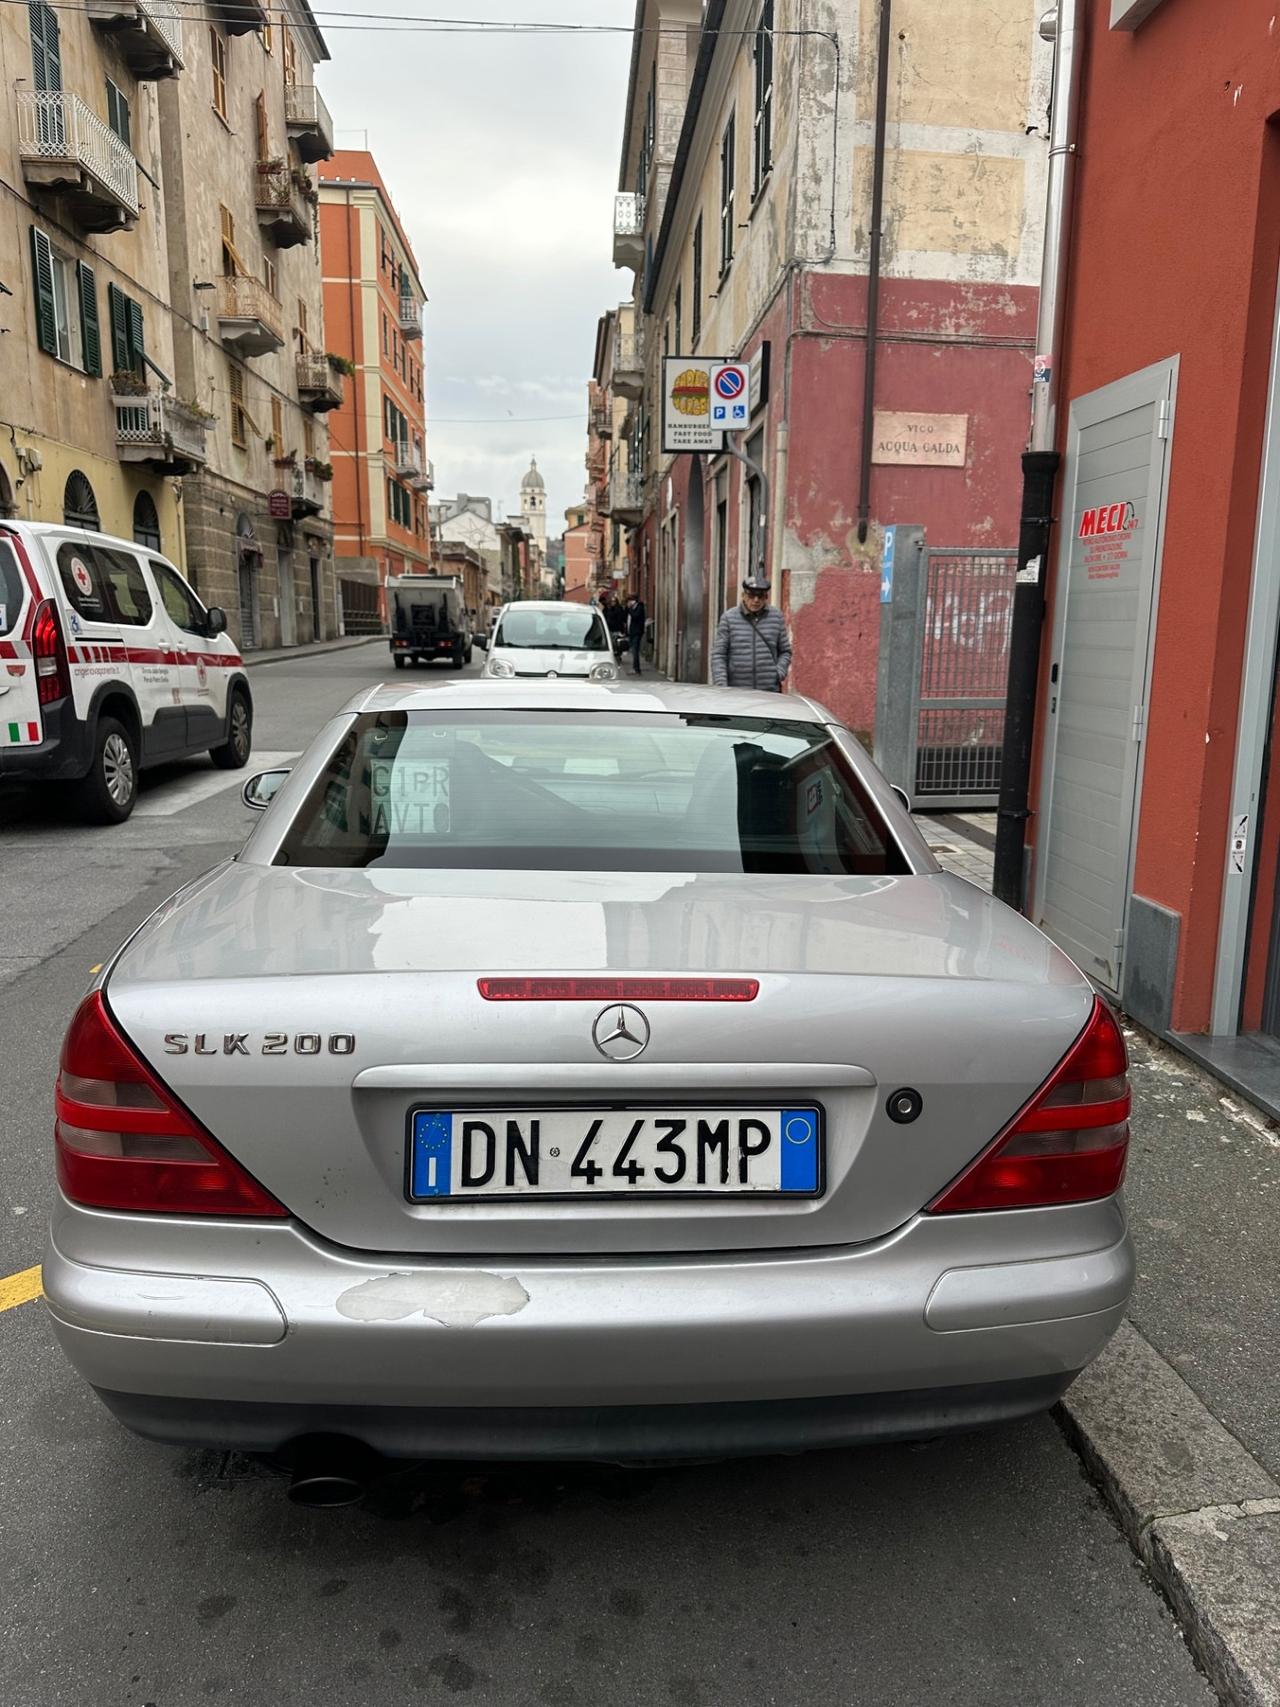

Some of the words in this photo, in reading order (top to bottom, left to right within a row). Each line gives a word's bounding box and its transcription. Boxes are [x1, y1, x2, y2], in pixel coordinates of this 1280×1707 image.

[906, 424, 934, 433] VICO
[879, 441, 918, 454] ACQUA
[923, 442, 961, 454] CALDA
[1079, 502, 1127, 538] MECI
[884, 531, 893, 557] P
[164, 1032, 250, 1055] SLK
[261, 1032, 356, 1055] 200
[460, 1120, 540, 1188] DN
